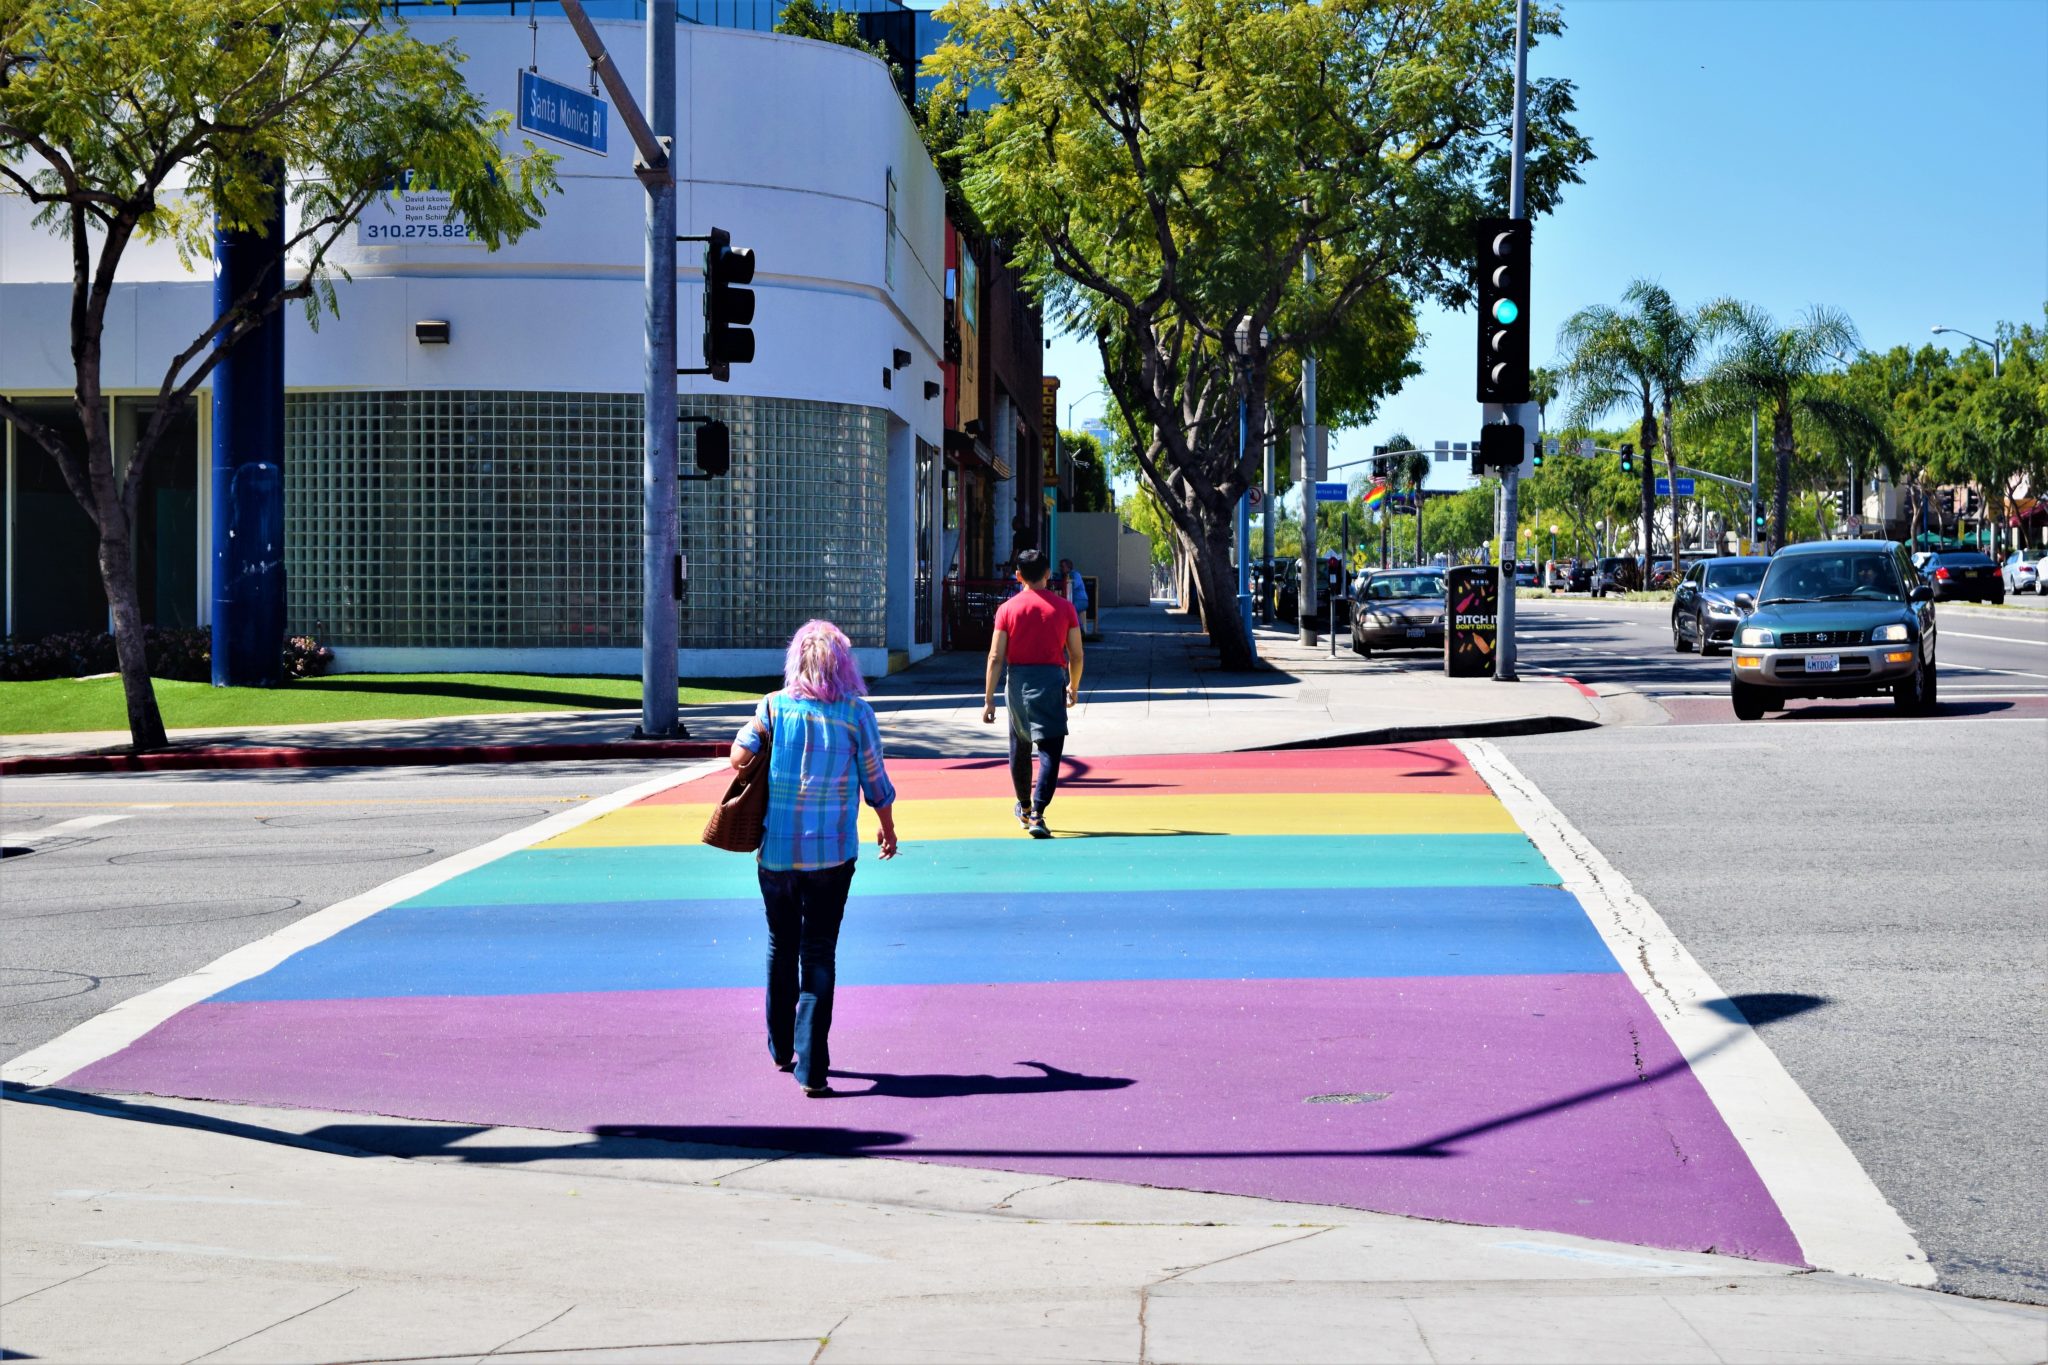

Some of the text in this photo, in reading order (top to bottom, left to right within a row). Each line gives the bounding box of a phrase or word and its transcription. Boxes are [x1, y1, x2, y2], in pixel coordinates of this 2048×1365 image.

[530, 88, 601, 138] Santa Monica Bl
[405, 195, 424, 203] David
[1042, 386, 1054, 477] LOCKSMITH
[1455, 614, 1489, 624] PITCH
